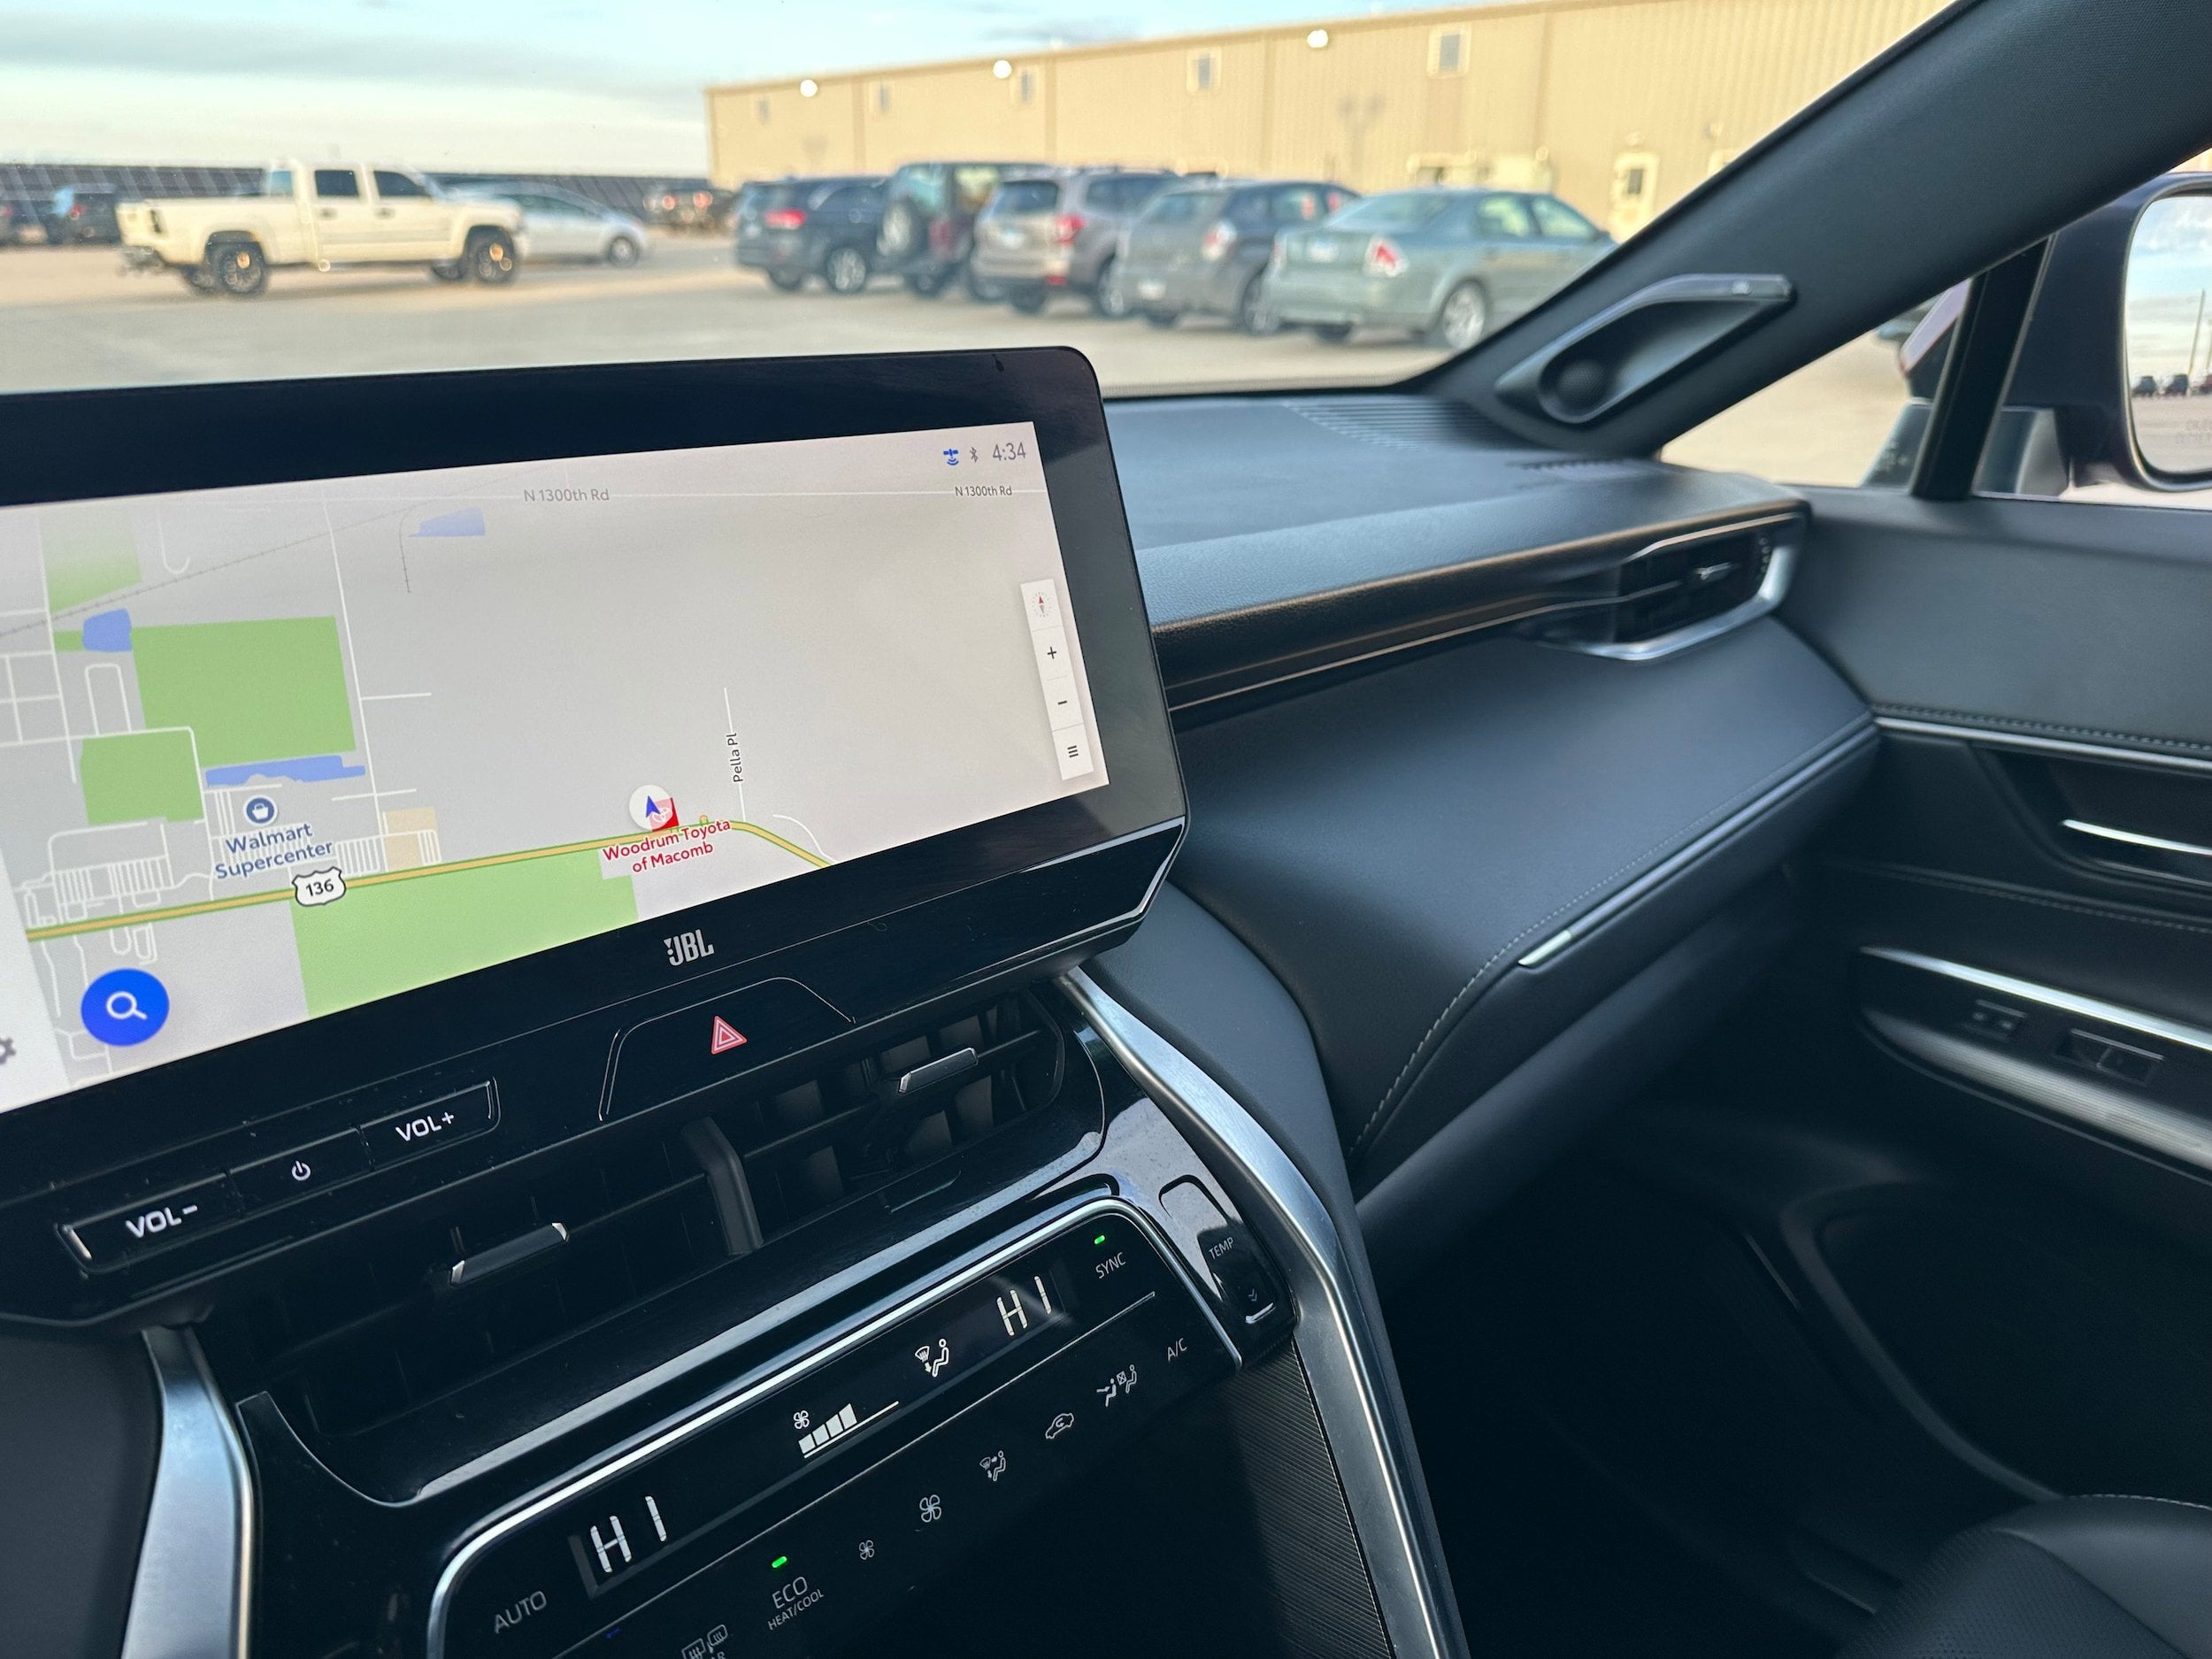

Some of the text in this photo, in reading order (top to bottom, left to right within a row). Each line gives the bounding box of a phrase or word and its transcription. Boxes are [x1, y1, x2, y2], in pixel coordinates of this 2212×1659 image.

[992, 442, 1026, 461] 4:34
[524, 488, 610, 502] N 1300th Rd
[955, 485, 1012, 496] N 1300th Rd
[726, 733, 743, 783] Pella Pl
[226, 824, 313, 854] Walmart
[603, 819, 731, 861] Woodrum Toyota
[215, 842, 333, 879] Supercenter
[632, 841, 713, 872] of Macomb
[305, 879, 334, 897] 136
[664, 929, 715, 966] JBL
[396, 1111, 455, 1142] VOL+
[1209, 1236, 1234, 1260] TEMP
[1095, 1251, 1126, 1279] SYNC
[1166, 1337, 1187, 1361] A/C
[772, 1576, 808, 1609] ECO
[494, 1590, 547, 1633] AUTO
[767, 1589, 825, 1631] HEAT/COOL
